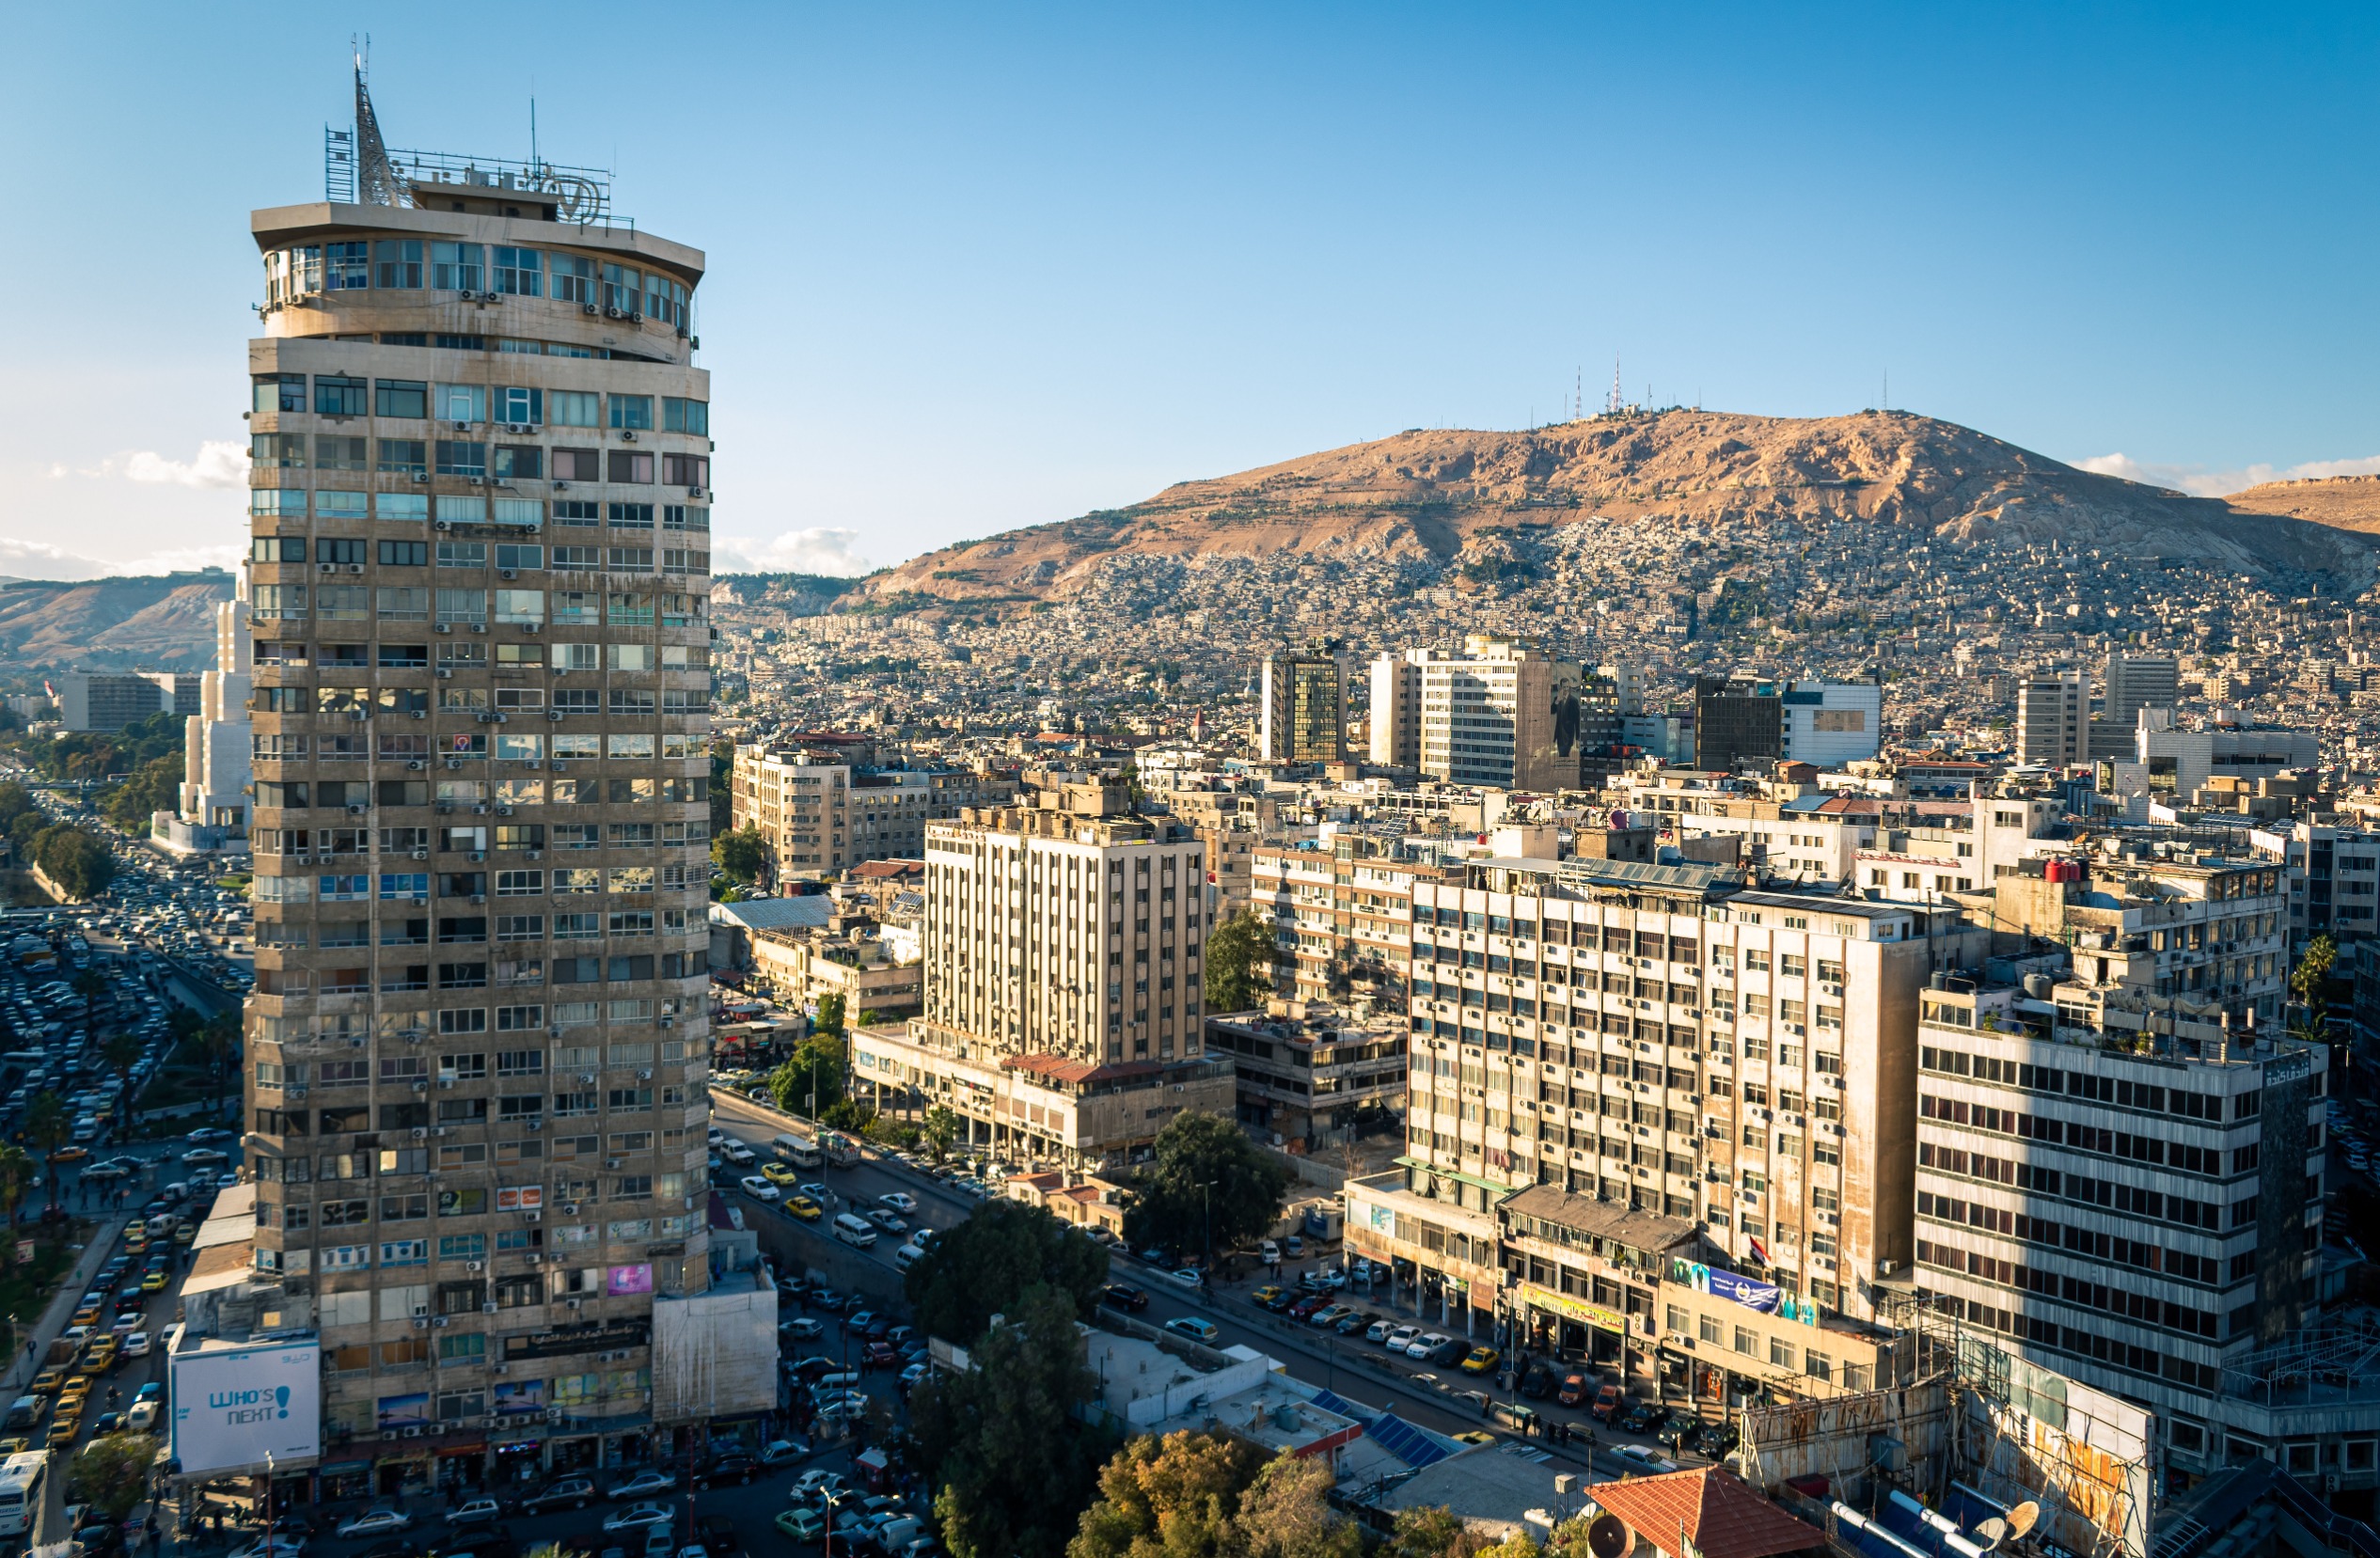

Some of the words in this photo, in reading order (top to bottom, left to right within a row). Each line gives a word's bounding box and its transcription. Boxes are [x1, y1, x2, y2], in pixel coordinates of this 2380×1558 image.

[1540, 1298, 1562, 1314] HOTEL
[1600, 1314, 1623, 1329] فندق
[210, 1388, 275, 1408] WHO'S
[228, 1407, 275, 1425] NEXT
